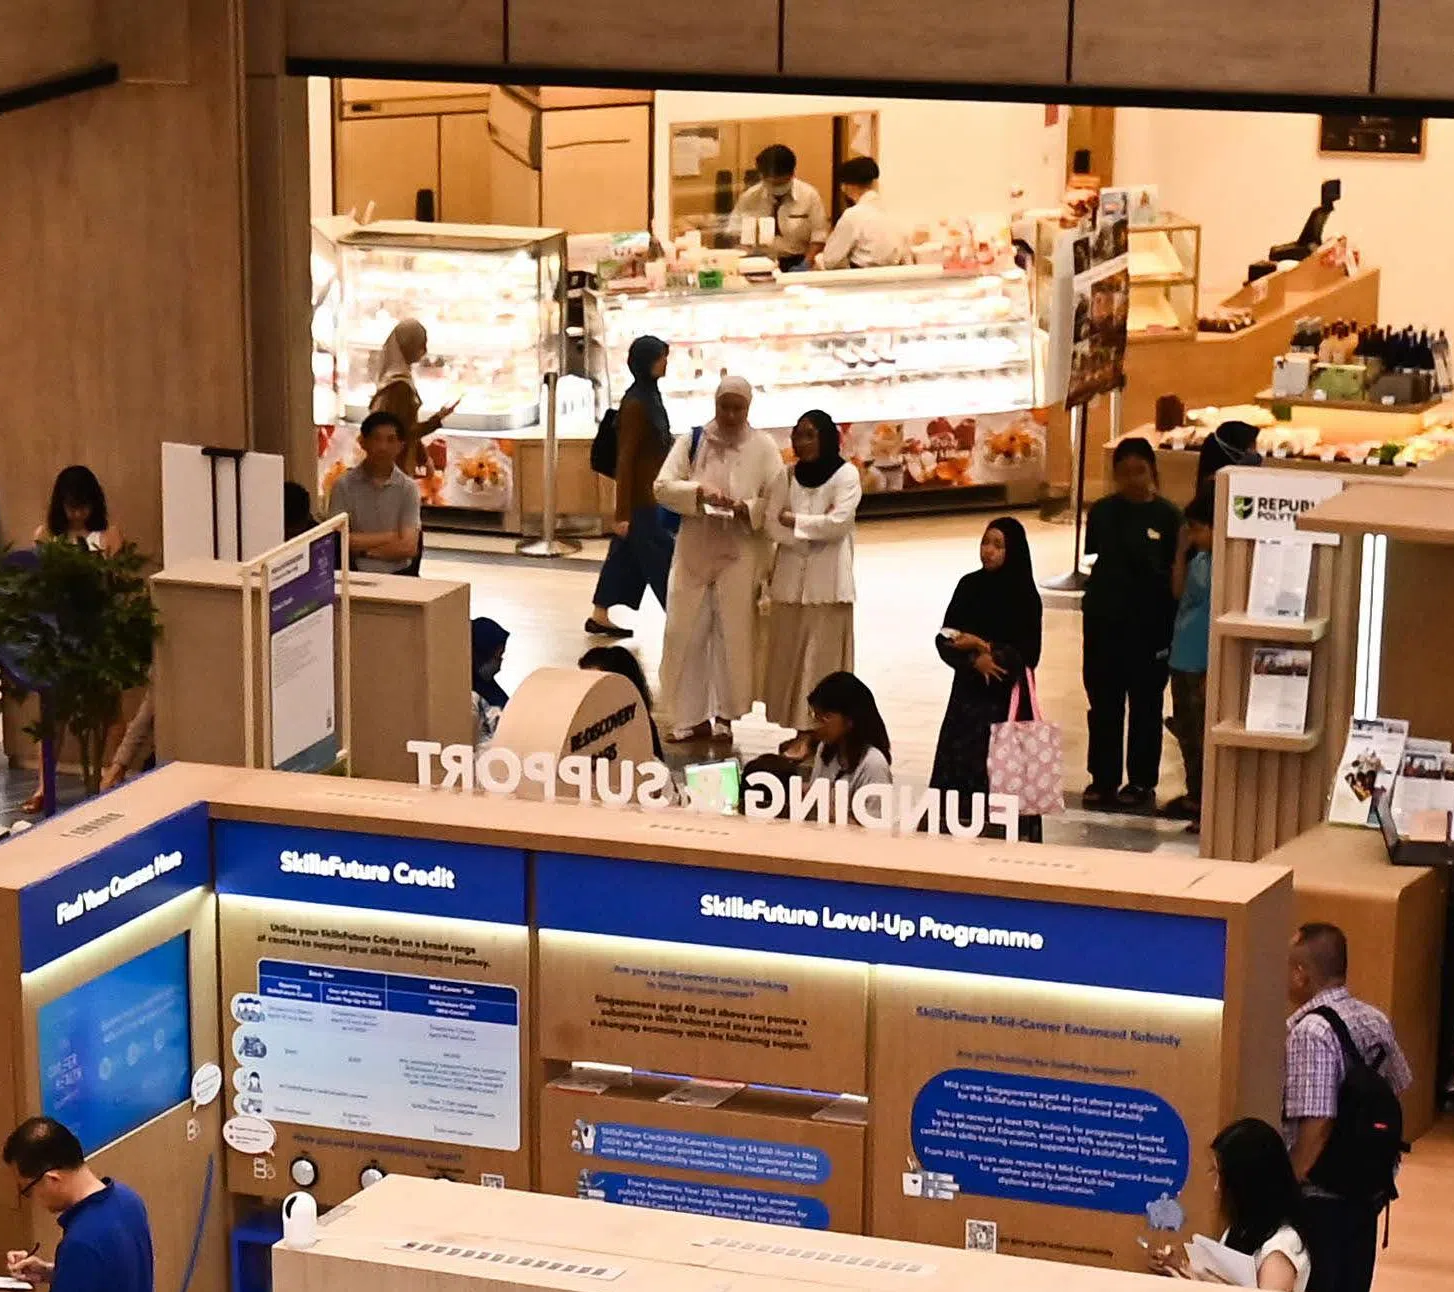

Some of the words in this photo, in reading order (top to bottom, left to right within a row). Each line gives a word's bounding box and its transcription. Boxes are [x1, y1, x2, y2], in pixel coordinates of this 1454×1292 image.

[56, 898, 83, 926] Find
[84, 882, 111, 913] Your
[108, 863, 154, 898] Courses
[151, 849, 183, 880] Here
[279, 850, 389, 884] SkillsFuture
[393, 861, 456, 890] Credit
[700, 893, 819, 929] SkillsFuture
[822, 906, 916, 942] Level-Up
[919, 916, 1045, 952] Programme
